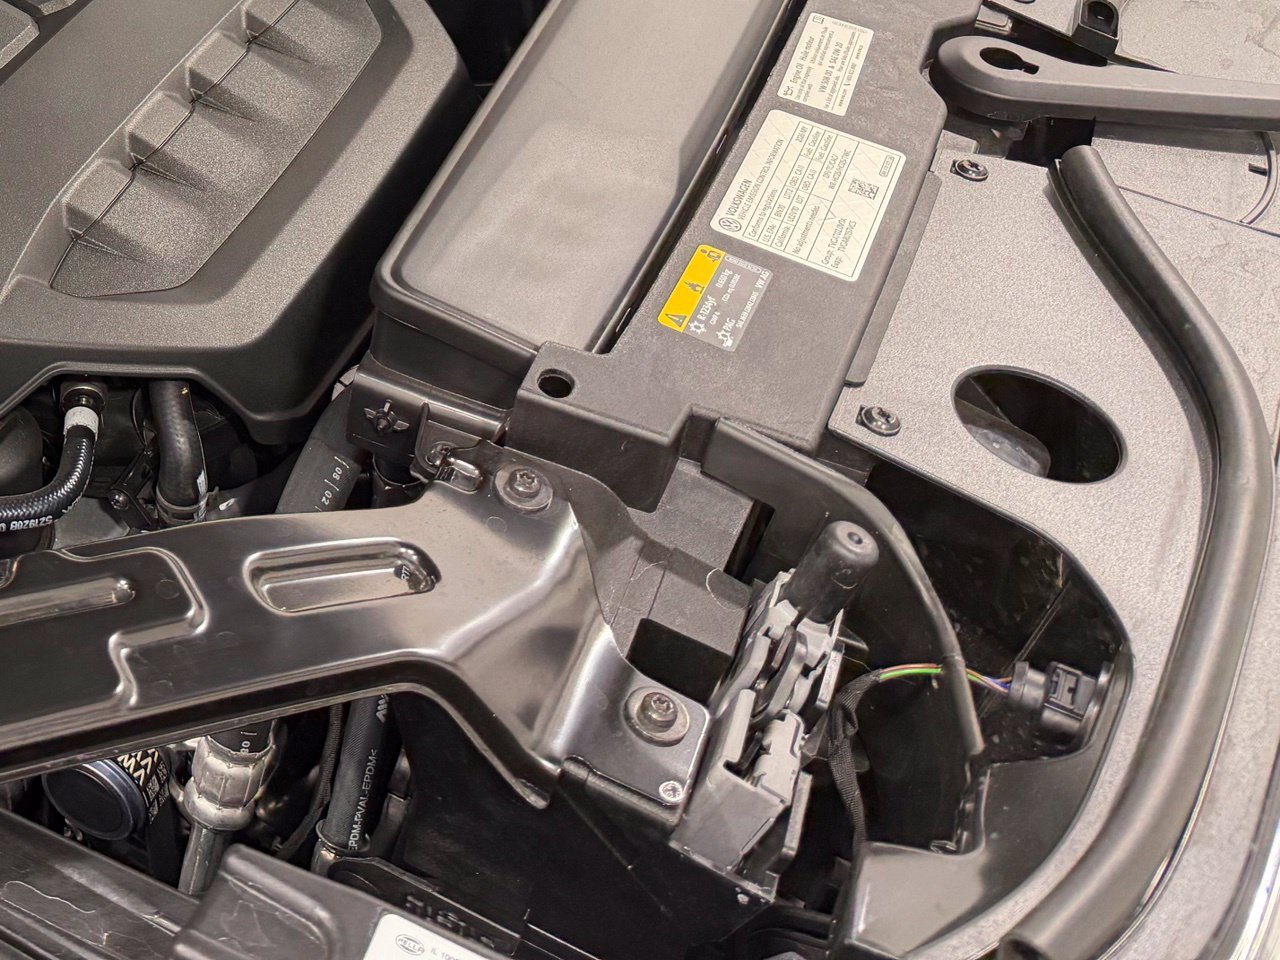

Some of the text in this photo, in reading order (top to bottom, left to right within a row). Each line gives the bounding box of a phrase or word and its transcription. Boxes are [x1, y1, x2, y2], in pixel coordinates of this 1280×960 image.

[799, 36, 814, 60] Huile moteur
[790, 69, 802, 83] Engine
[795, 132, 804, 141] 2026
[803, 130, 821, 156] Fuel: Gasoline
[815, 134, 833, 160] Fuel: Gasoline
[737, 138, 783, 219] VEHICLE EMISSION CONTROL INFORMATION
[726, 178, 752, 216] VOLKSWAGEN
[748, 216, 763, 237] Conforms
[761, 187, 779, 212] regulations:
[774, 224, 790, 247] California:
[795, 220, 814, 247] adjustments
[755, 270, 768, 288] VW AG
[696, 295, 718, 321] R-1234yf
[722, 318, 735, 330] PAG
[398, 937, 425, 955] HELLA
